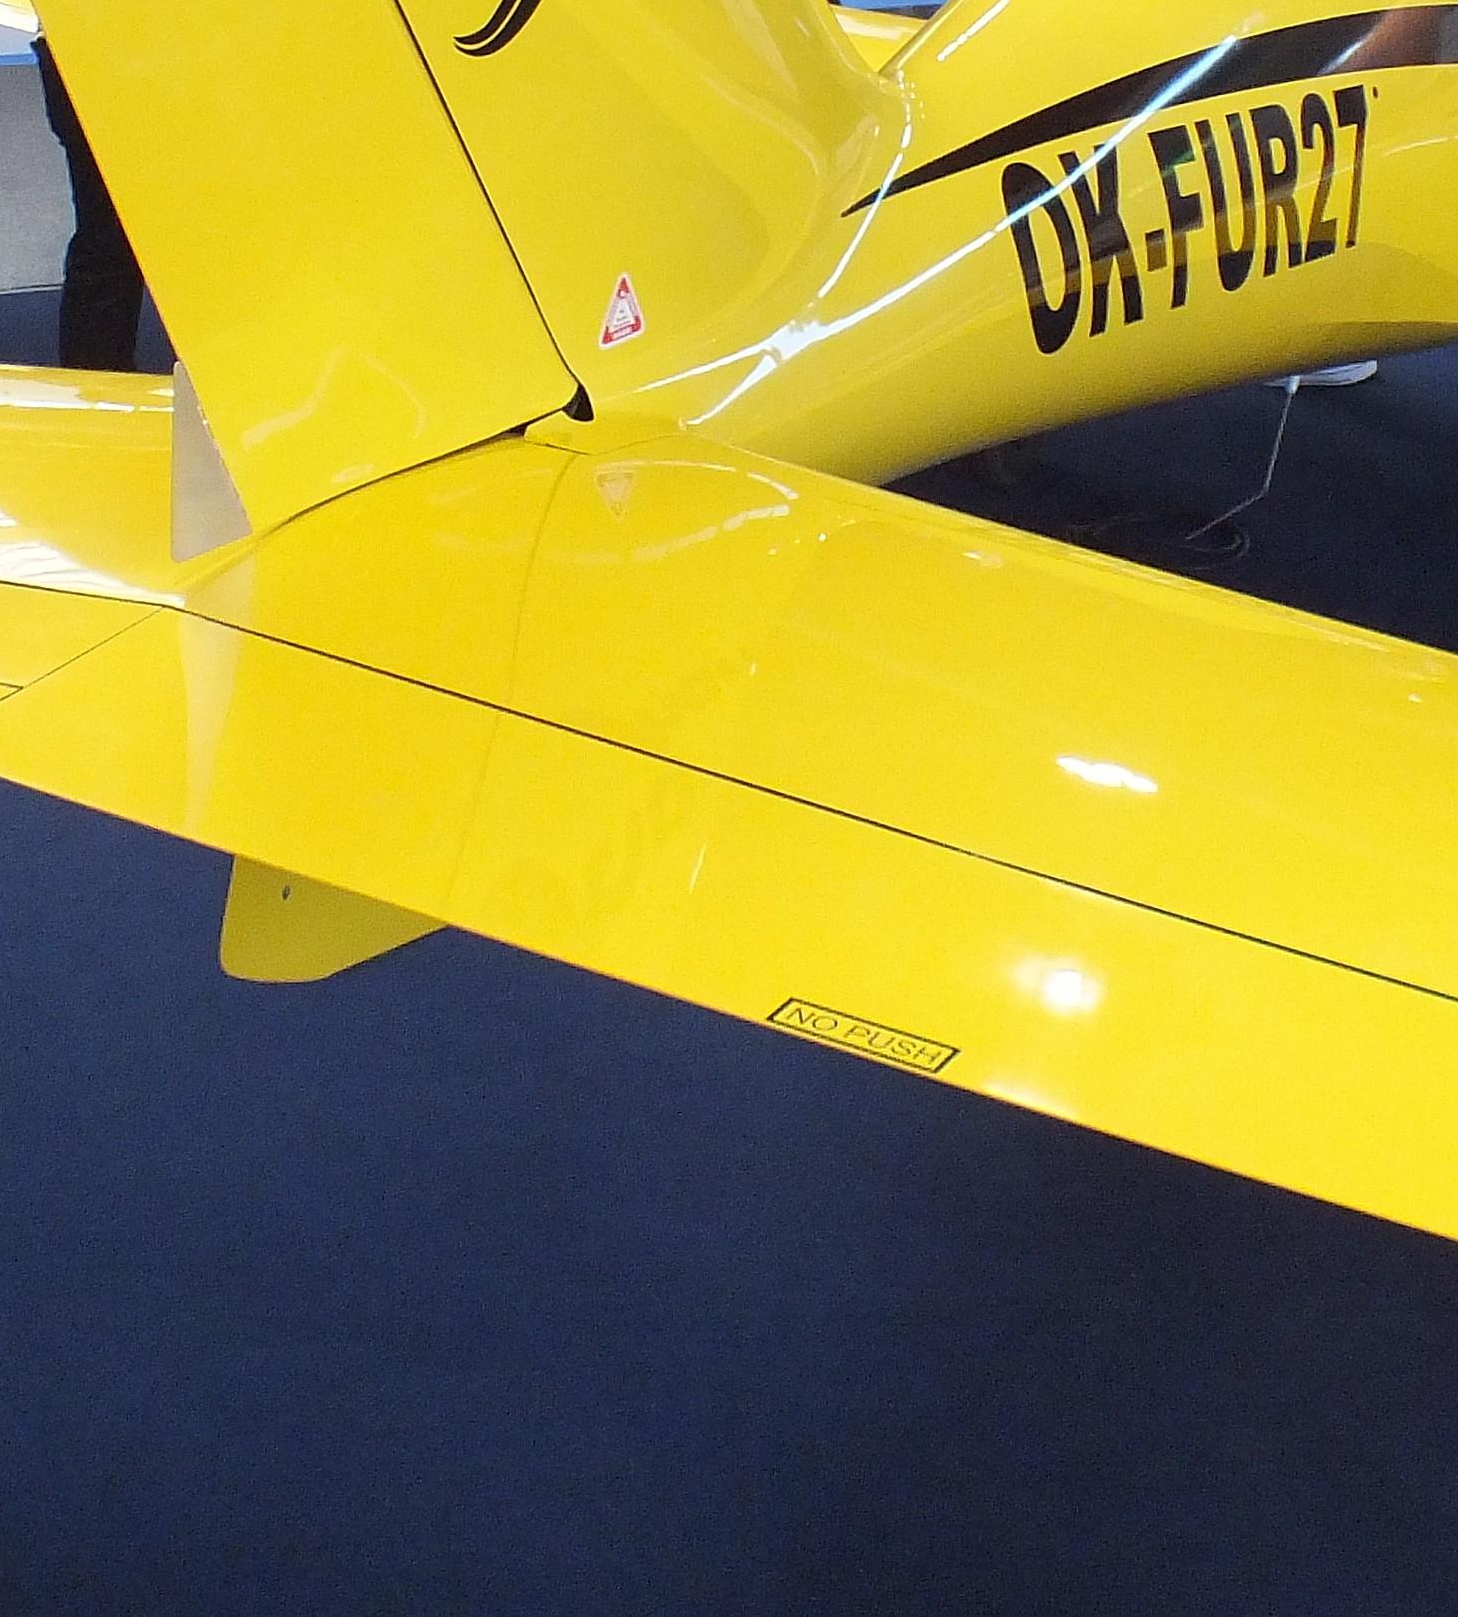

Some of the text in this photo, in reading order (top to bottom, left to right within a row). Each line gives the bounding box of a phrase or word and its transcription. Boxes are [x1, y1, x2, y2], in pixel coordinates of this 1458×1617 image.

[1001, 84, 1368, 355] OK-FUR27
[785, 1007, 942, 1065] NO PUSH
